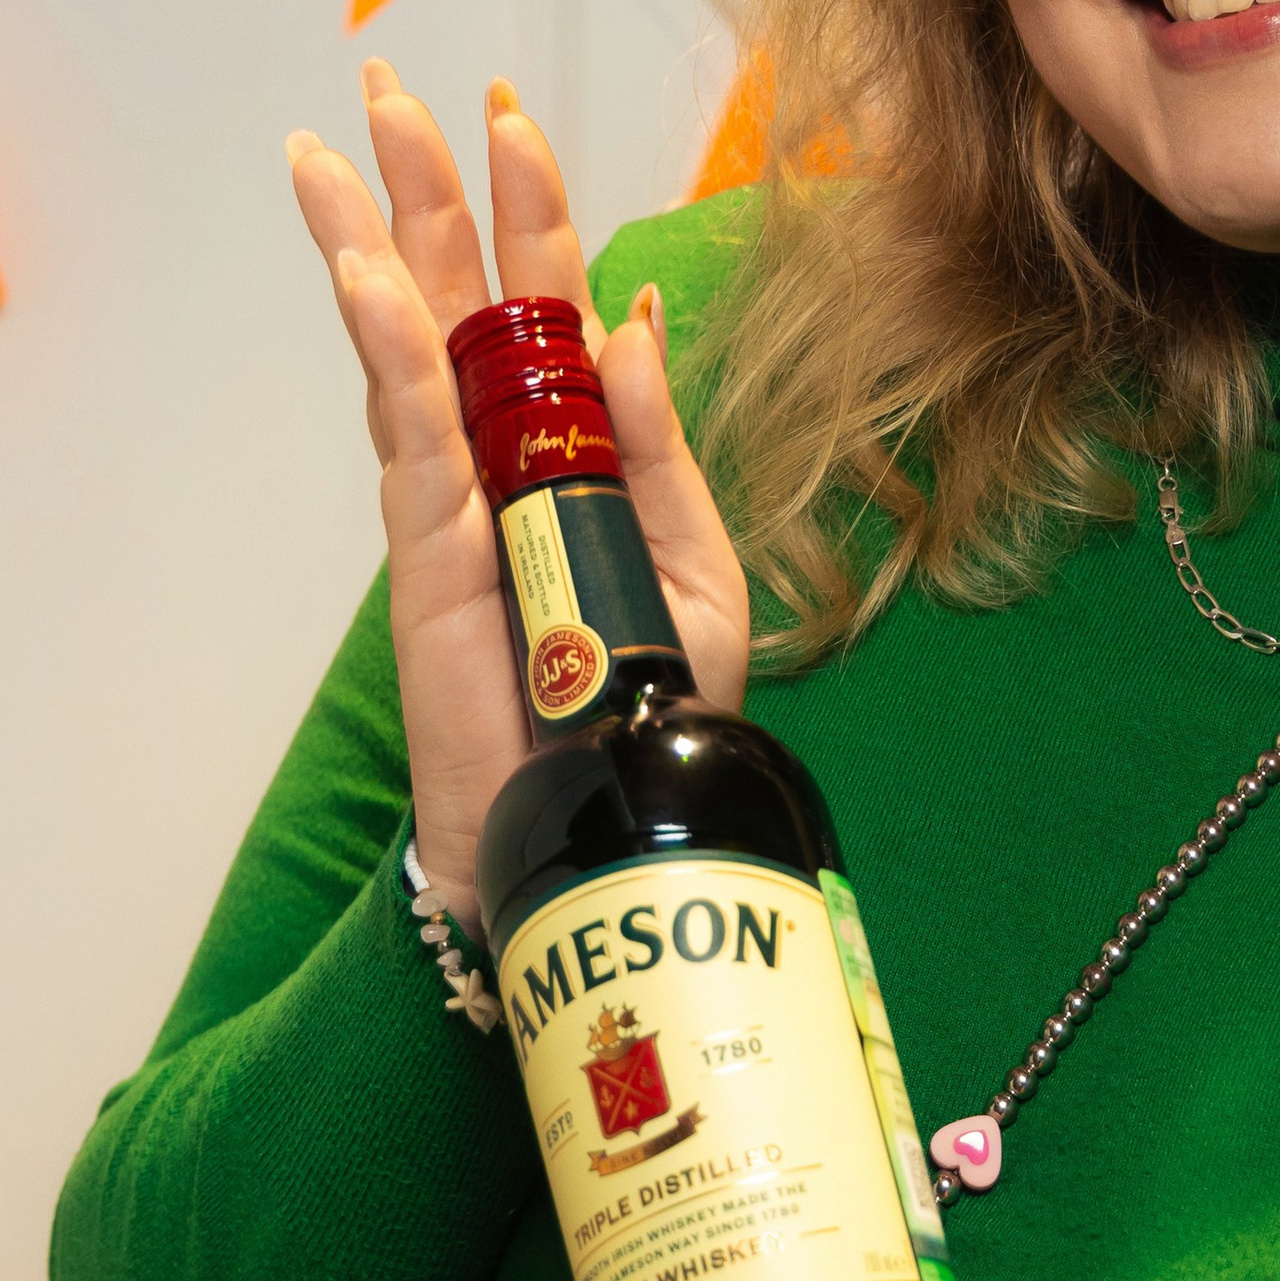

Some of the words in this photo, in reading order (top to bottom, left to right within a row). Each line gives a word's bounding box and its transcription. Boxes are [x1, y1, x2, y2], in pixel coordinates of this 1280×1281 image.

[520, 428, 566, 471] John
[521, 513, 538, 561] MATURED
[517, 542, 524, 555] IN
[521, 555, 535, 600] IRELAND
[533, 563, 540, 571] &
[538, 535, 556, 585] DISTILLED
[534, 571, 550, 617] BOTTLED
[546, 631, 592, 655] JAMESON
[541, 648, 582, 689] JJ&S
[563, 662, 595, 703] LIMITED
[511, 898, 782, 1065] AMESON
[701, 1037, 762, 1066] 1780
[574, 1194, 633, 1250] TRIPLE
[639, 1143, 782, 1208] DISTILLED
[611, 1236, 644, 1263] IRISH
[646, 1206, 716, 1242] WHISKEY
[722, 1190, 768, 1213] MADE
[776, 1181, 807, 1197] THE
[667, 1231, 700, 1253] WAY
[705, 1214, 754, 1239] SINCE
